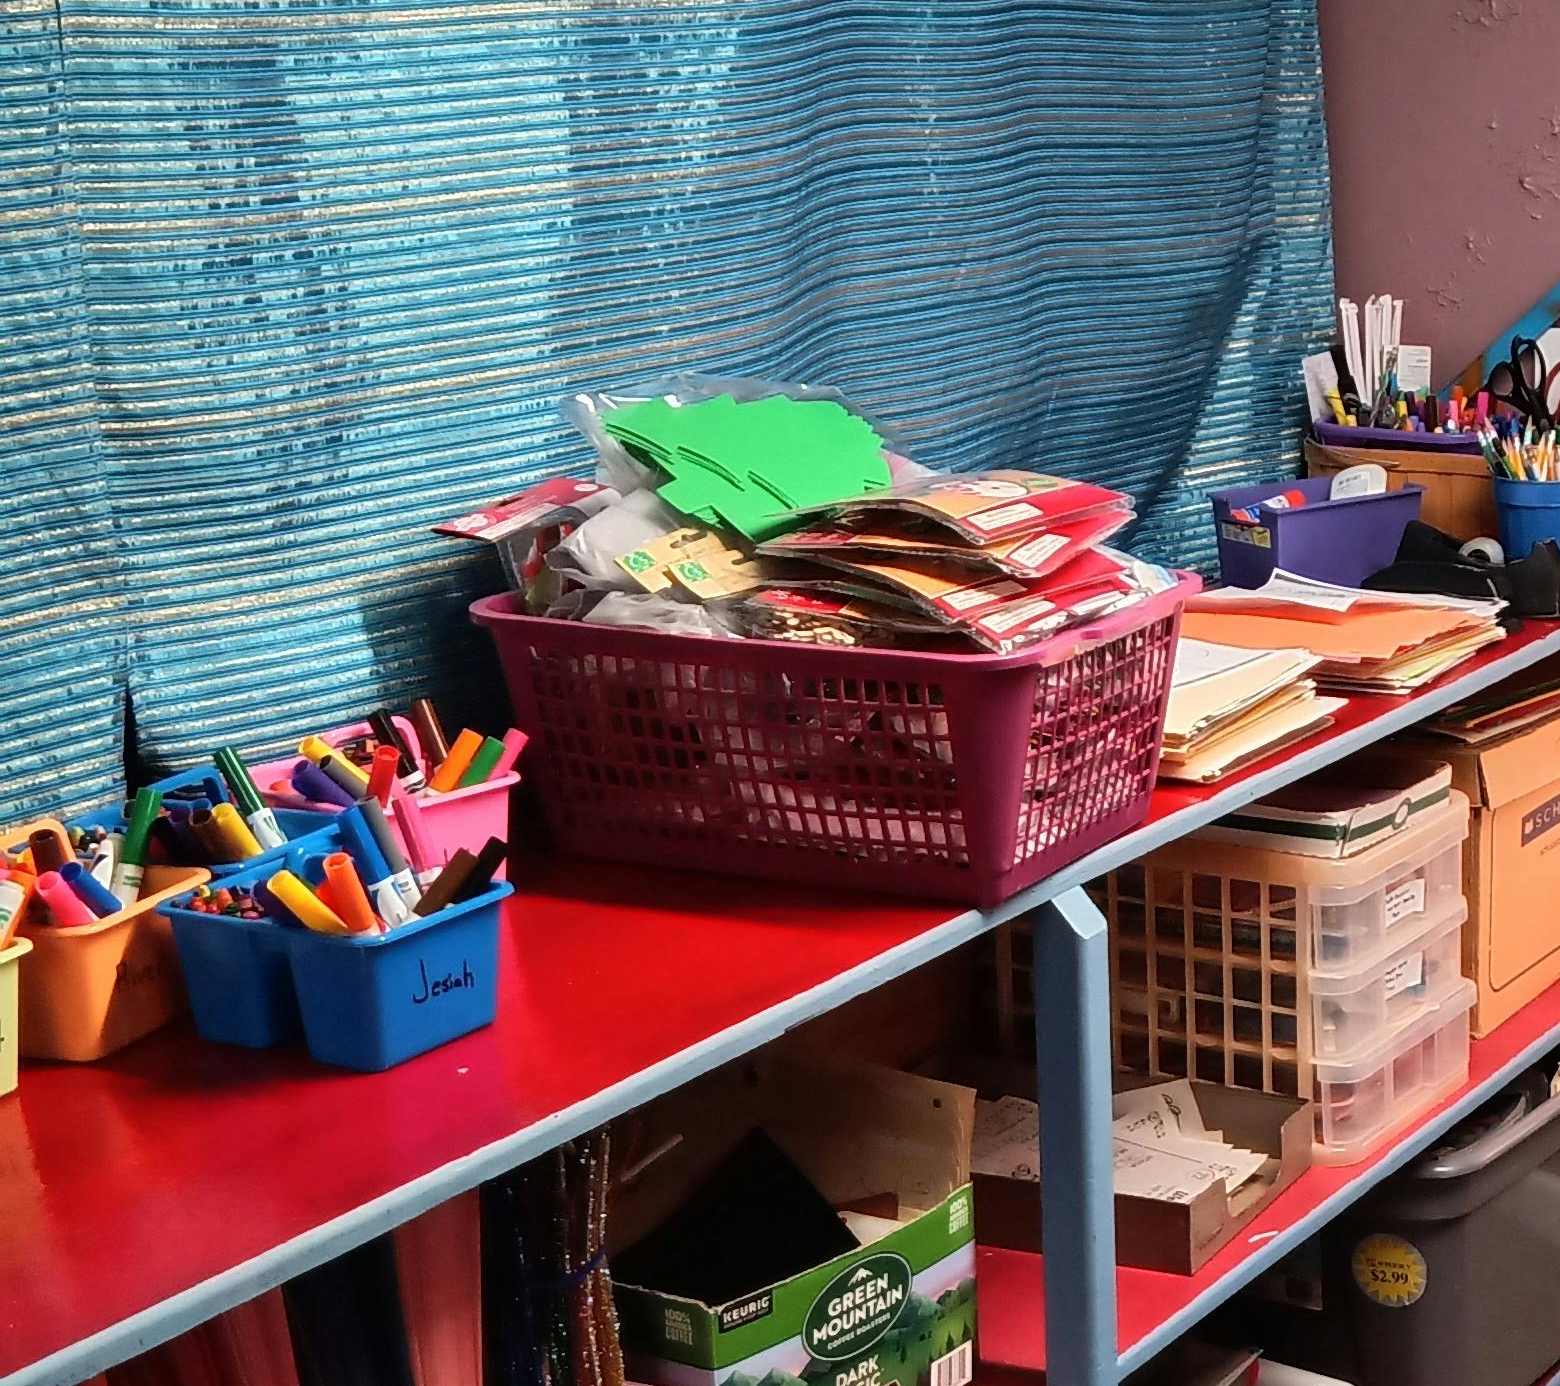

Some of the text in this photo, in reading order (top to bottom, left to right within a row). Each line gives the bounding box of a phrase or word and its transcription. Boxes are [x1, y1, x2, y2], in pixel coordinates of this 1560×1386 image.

[1371, 1268, 1409, 1284] $2.99
[828, 1273, 889, 1317] GREEN
[724, 1297, 769, 1323] KEURIG
[813, 1284, 903, 1345] MOUNTAIN
[828, 1331, 855, 1349] COFFEE
